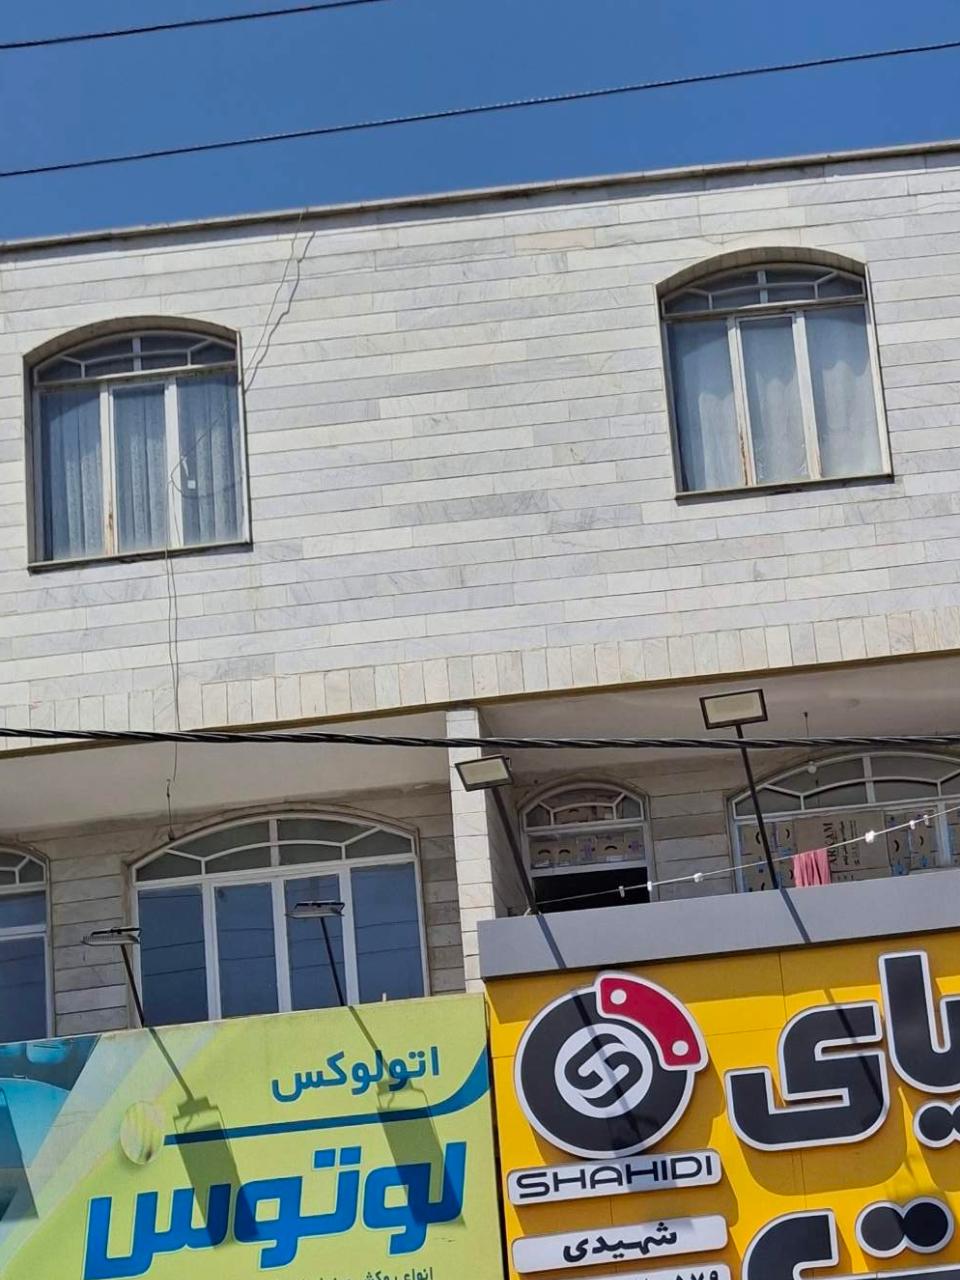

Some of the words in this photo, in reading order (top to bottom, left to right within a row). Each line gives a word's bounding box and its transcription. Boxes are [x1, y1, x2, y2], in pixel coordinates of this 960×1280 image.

[271, 1046, 440, 1103] اتولوکس
[516, 1155, 713, 1199] SHAHIDI
[562, 1221, 678, 1263] شهیدی
